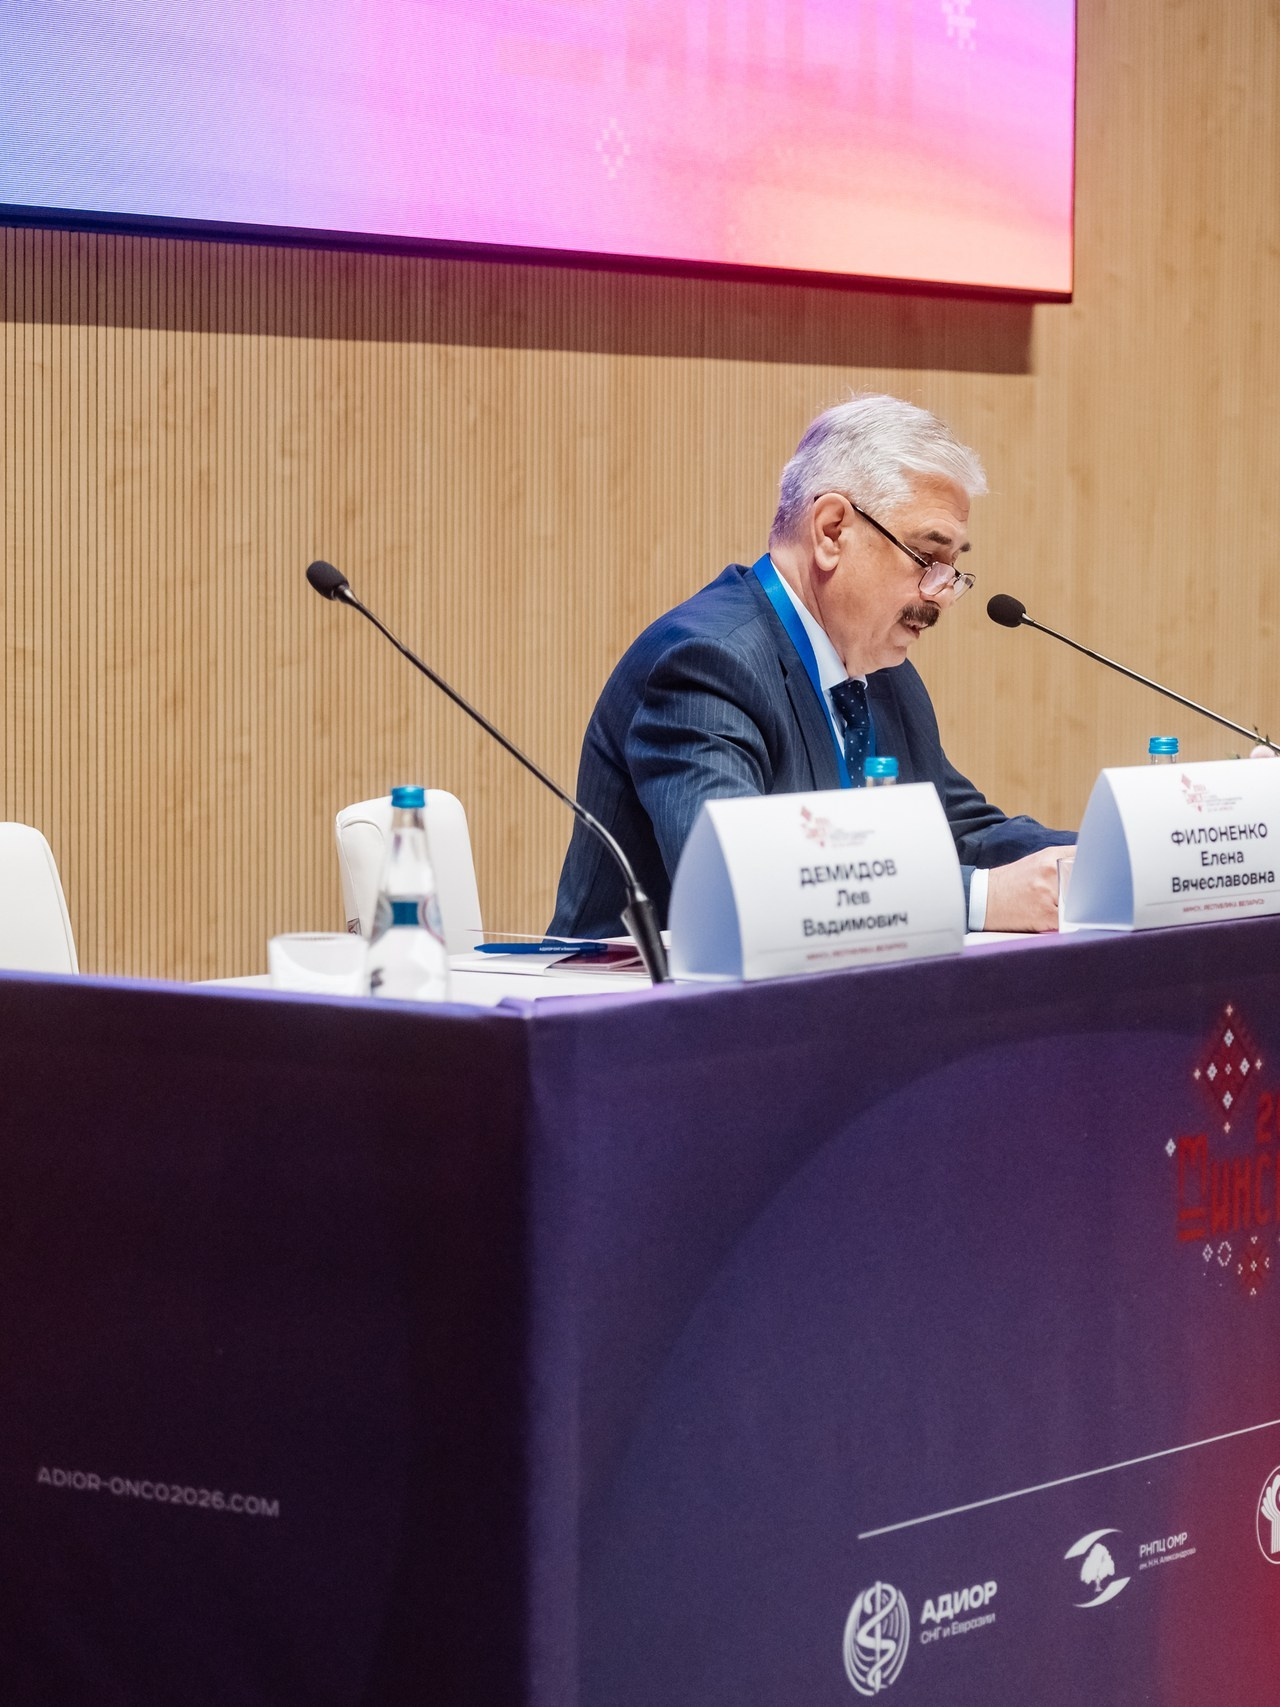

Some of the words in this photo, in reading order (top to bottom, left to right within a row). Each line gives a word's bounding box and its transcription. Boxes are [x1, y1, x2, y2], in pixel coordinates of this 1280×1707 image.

[1171, 822, 1268, 846] ФИЛОНЕНКО
[1201, 851, 1244, 867] Елена
[800, 859, 897, 888] ДЕМИДОВ
[1172, 870, 1275, 893] Вячеславовна
[837, 889, 871, 907] Лев
[803, 911, 909, 937] Вадимович
[37, 1466, 280, 1518] ADIOR-ONCO2026.COM
[1139, 1538, 1166, 1558] РНПЦ
[1167, 1531, 1188, 1549] ОМР
[920, 1580, 998, 1625] АДИОР
[920, 1626, 942, 1644] СНГ
[943, 1627, 951, 1638] и
[951, 1612, 996, 1636] Евразии
